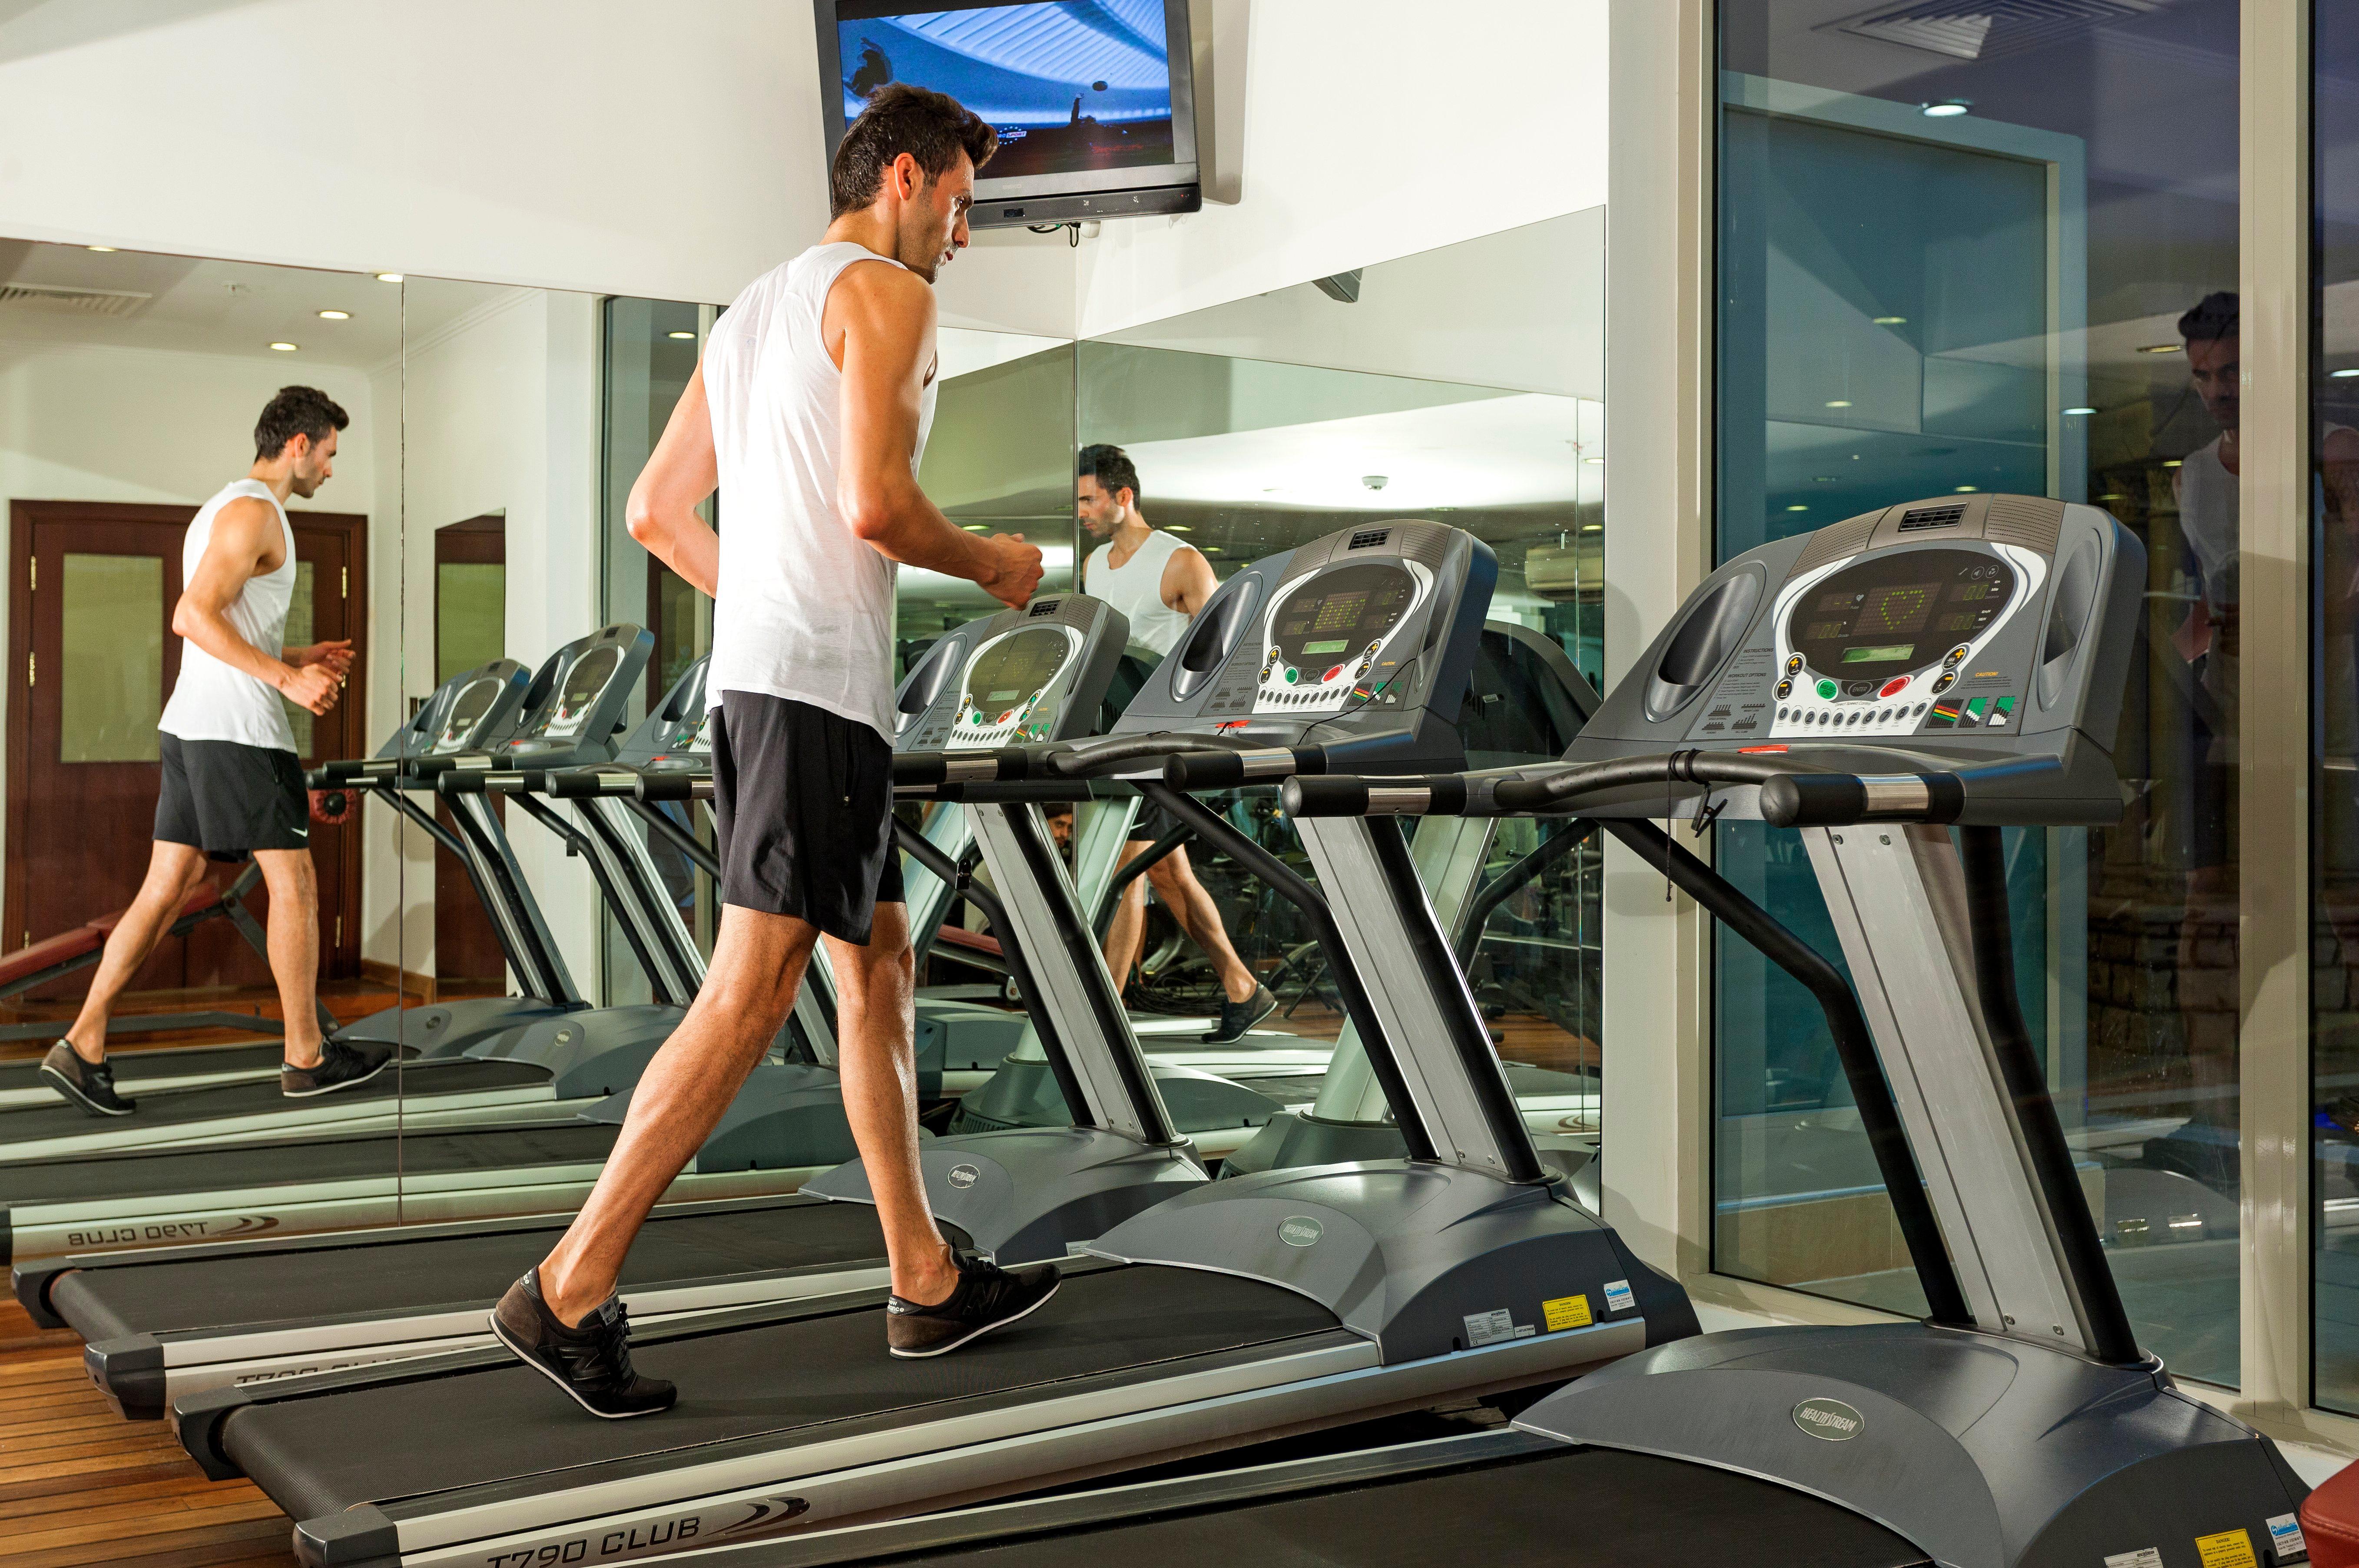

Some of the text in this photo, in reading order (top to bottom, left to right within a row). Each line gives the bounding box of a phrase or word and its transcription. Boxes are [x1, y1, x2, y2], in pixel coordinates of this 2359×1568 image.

[1780, 709, 1787, 718] 0
[1898, 709, 1906, 718] 8
[1916, 705, 1924, 714] 9
[1793, 712, 1799, 721] 1
[1806, 714, 1814, 722] 2
[1820, 715, 1827, 724] 3
[1835, 715, 1843, 724] 4
[1849, 714, 1857, 723] 5
[1865, 713, 1872, 722] 6
[1882, 711, 1890, 721] 7
[1283, 1224, 1319, 1239] HEALTHSTREAM
[1799, 1407, 1858, 1432] HEALTHSTREAM
[600, 1515, 702, 1556] CLUB
